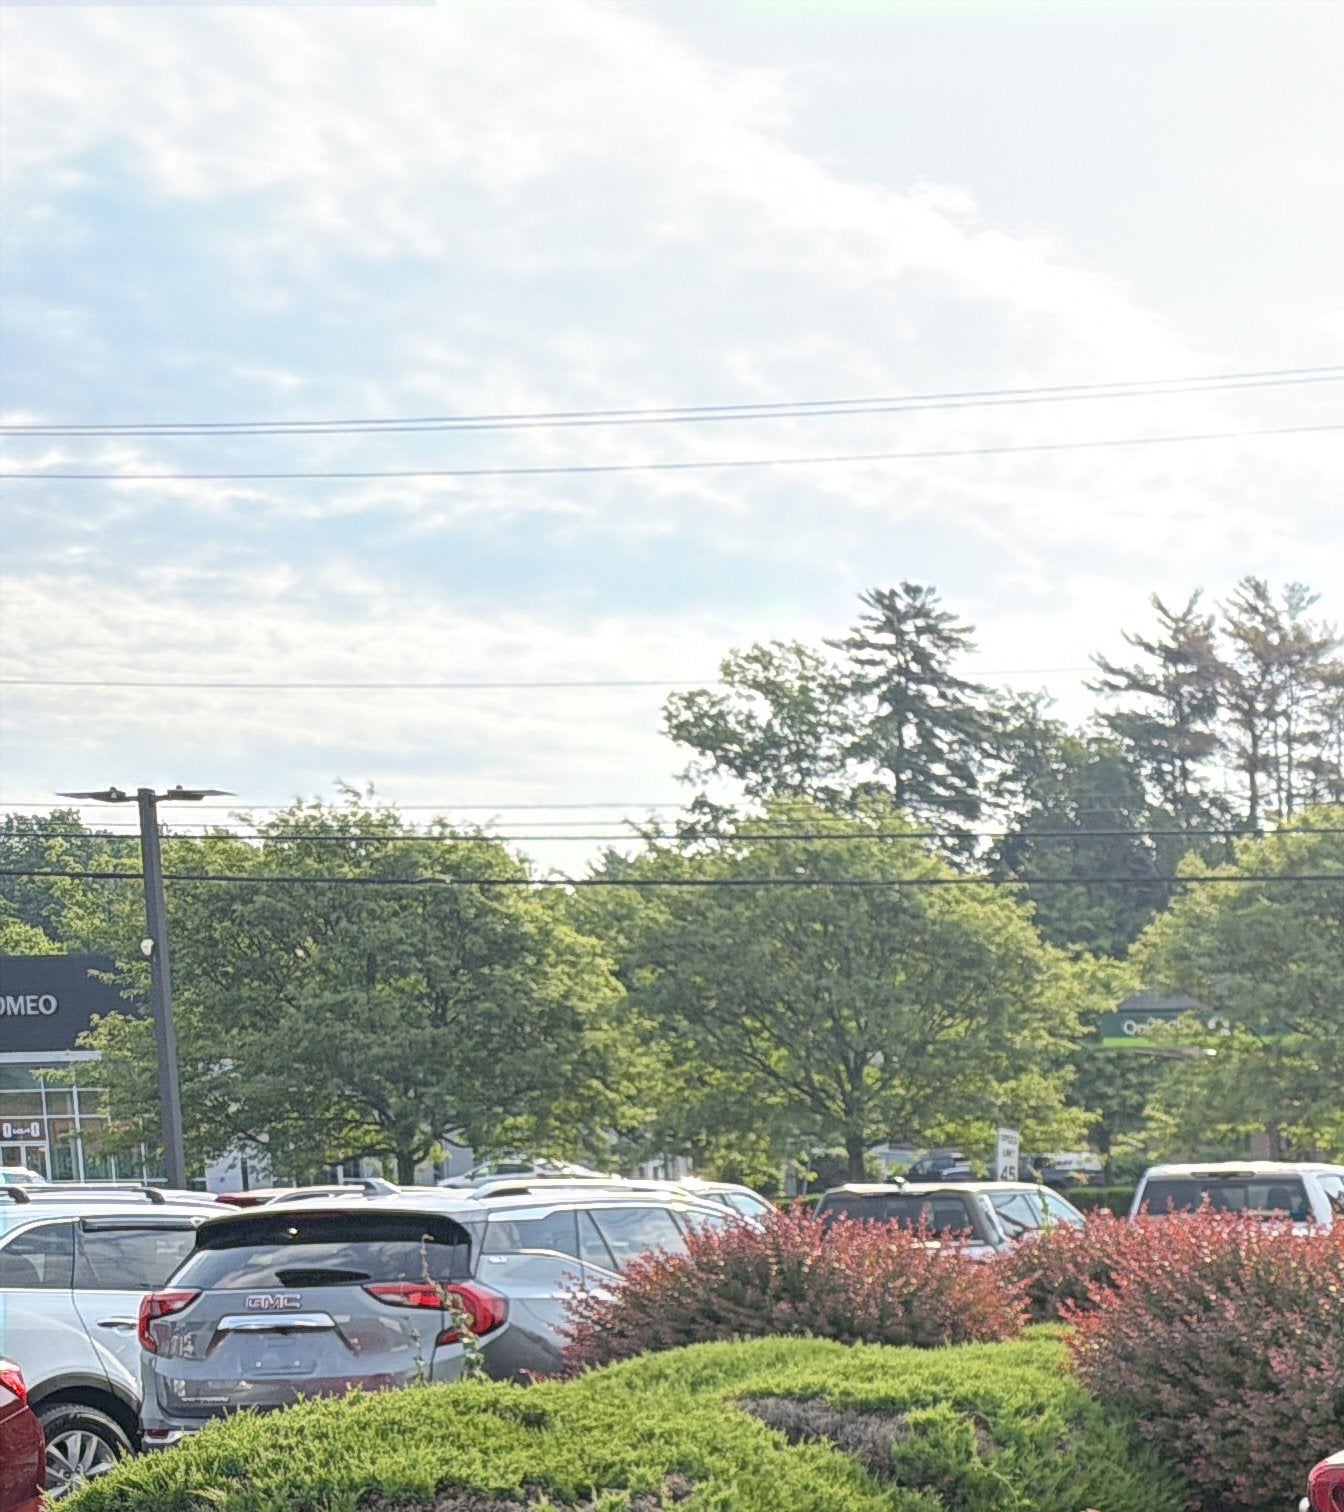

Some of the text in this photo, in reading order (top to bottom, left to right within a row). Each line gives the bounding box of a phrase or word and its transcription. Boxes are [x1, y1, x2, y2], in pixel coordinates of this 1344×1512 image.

[0, 994, 59, 1017] MEO
[1000, 1165, 1017, 1182] 45
[244, 1293, 302, 1310] GMC
